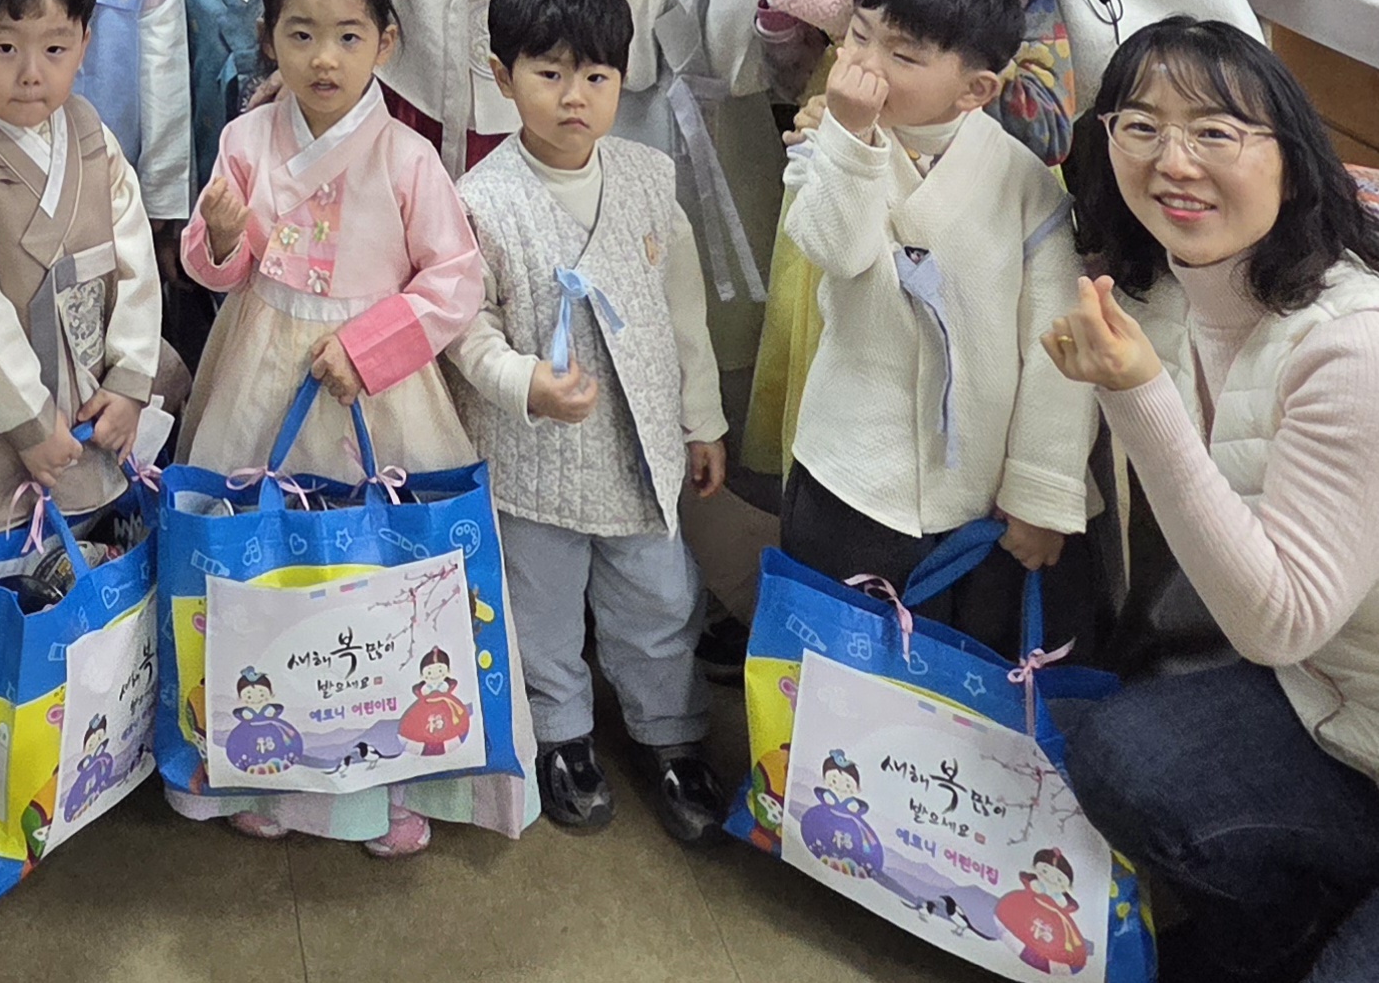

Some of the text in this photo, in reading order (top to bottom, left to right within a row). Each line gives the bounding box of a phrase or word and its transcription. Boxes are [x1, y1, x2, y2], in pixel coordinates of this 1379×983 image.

[287, 626, 395, 679] 새해 복 많이
[317, 676, 369, 699] 받으세요
[351, 697, 397, 716] 어린이집
[880, 755, 1007, 818] 새해 복 많이
[909, 797, 969, 837] 받으세요
[943, 848, 999, 886] 어린이집
